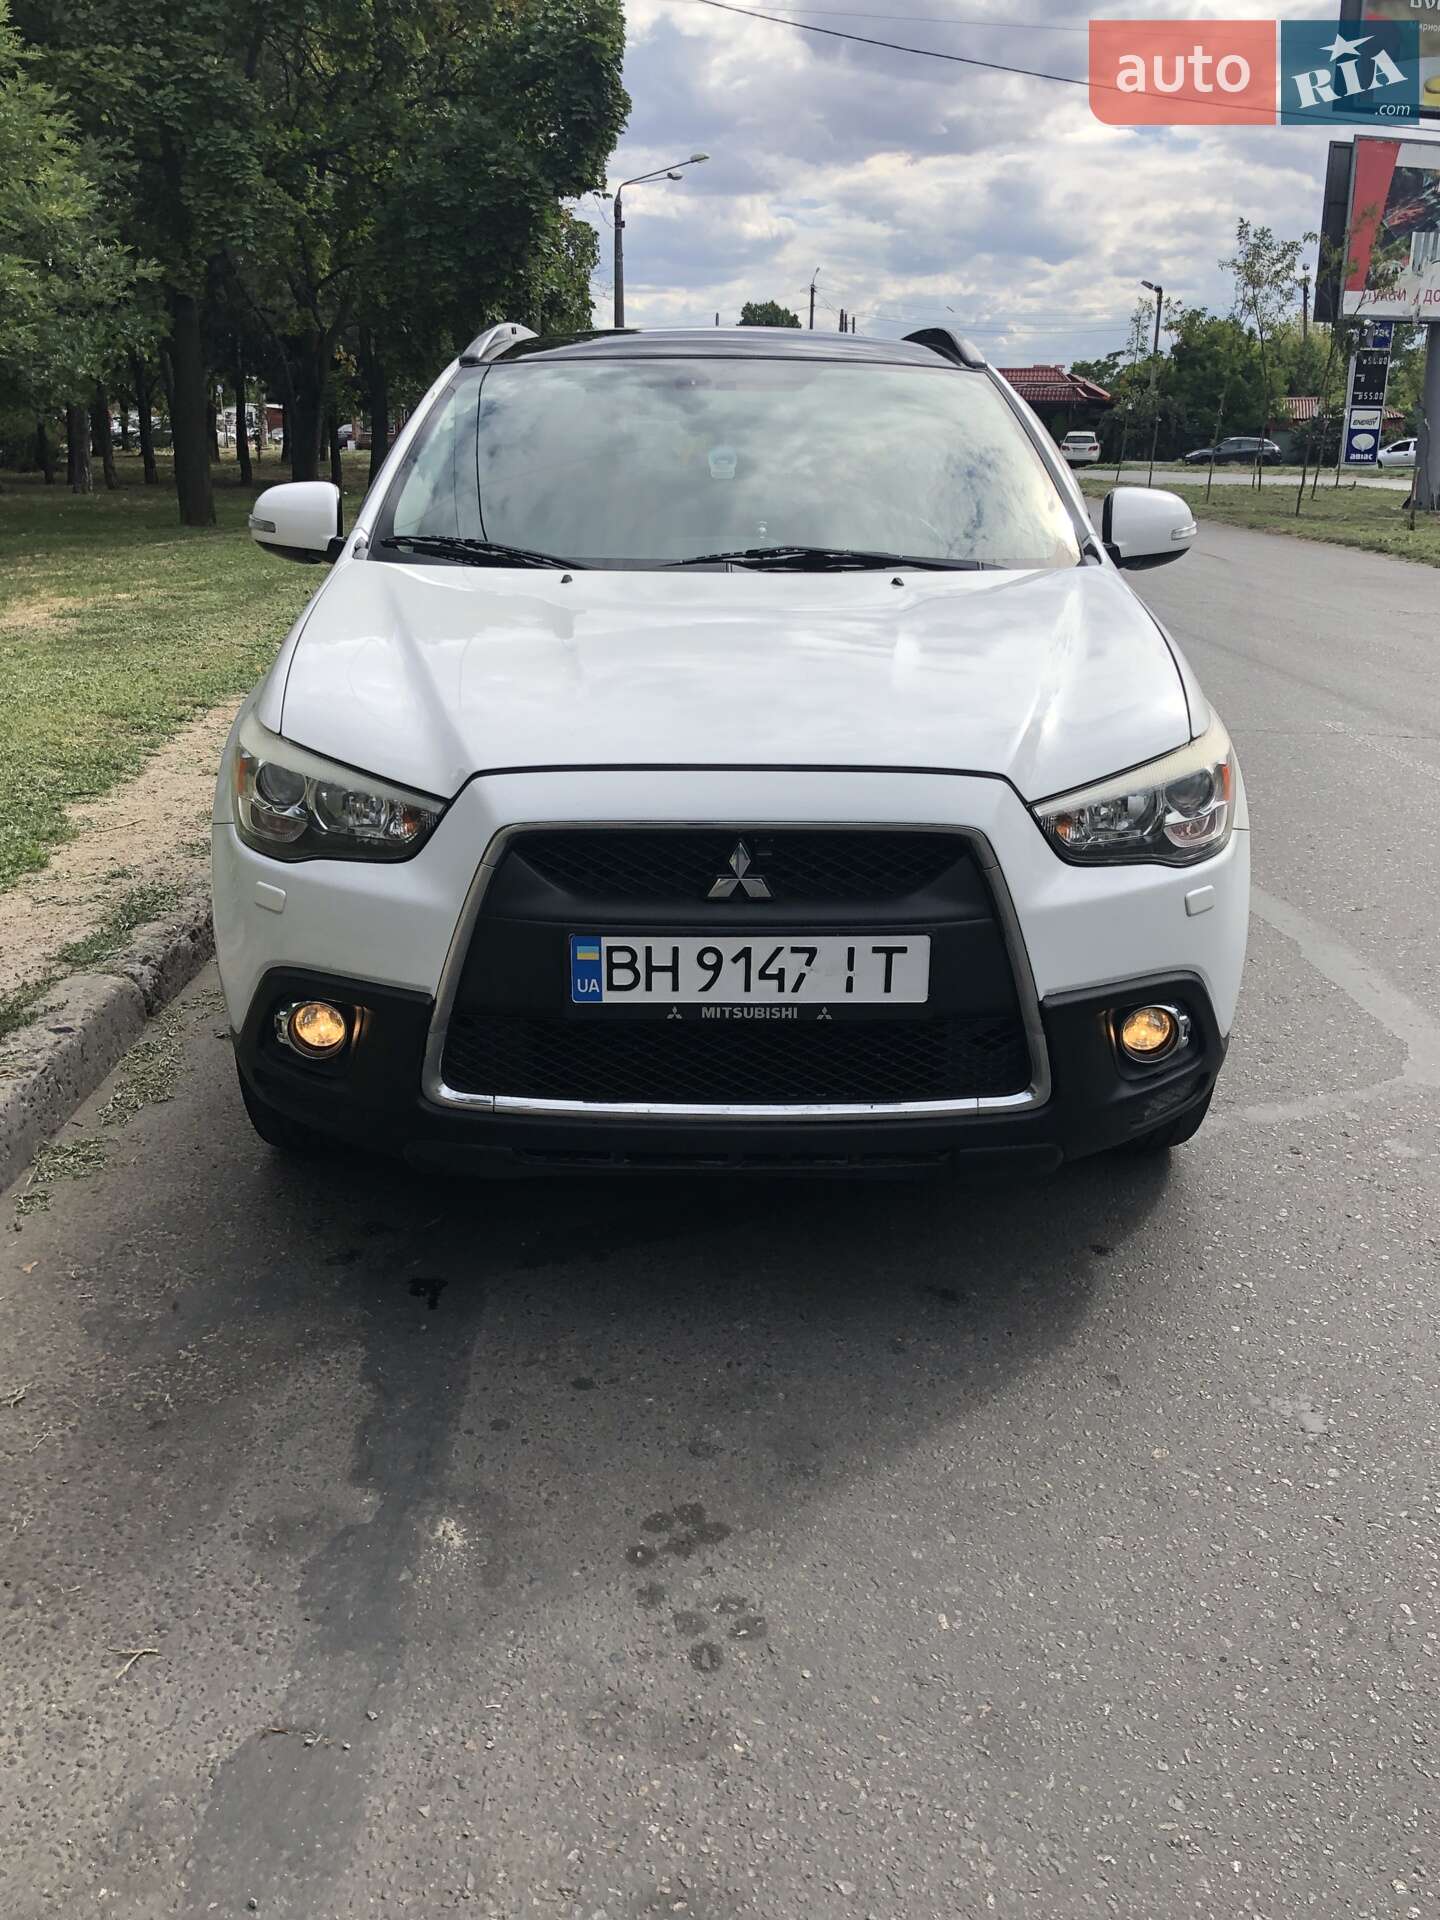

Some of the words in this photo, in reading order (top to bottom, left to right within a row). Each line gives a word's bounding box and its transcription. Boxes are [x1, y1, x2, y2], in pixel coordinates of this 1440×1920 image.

[606, 945, 680, 993] BH
[696, 945, 818, 993] 9147
[577, 978, 600, 993] UA
[701, 1006, 799, 1020] MITSUBISHI
